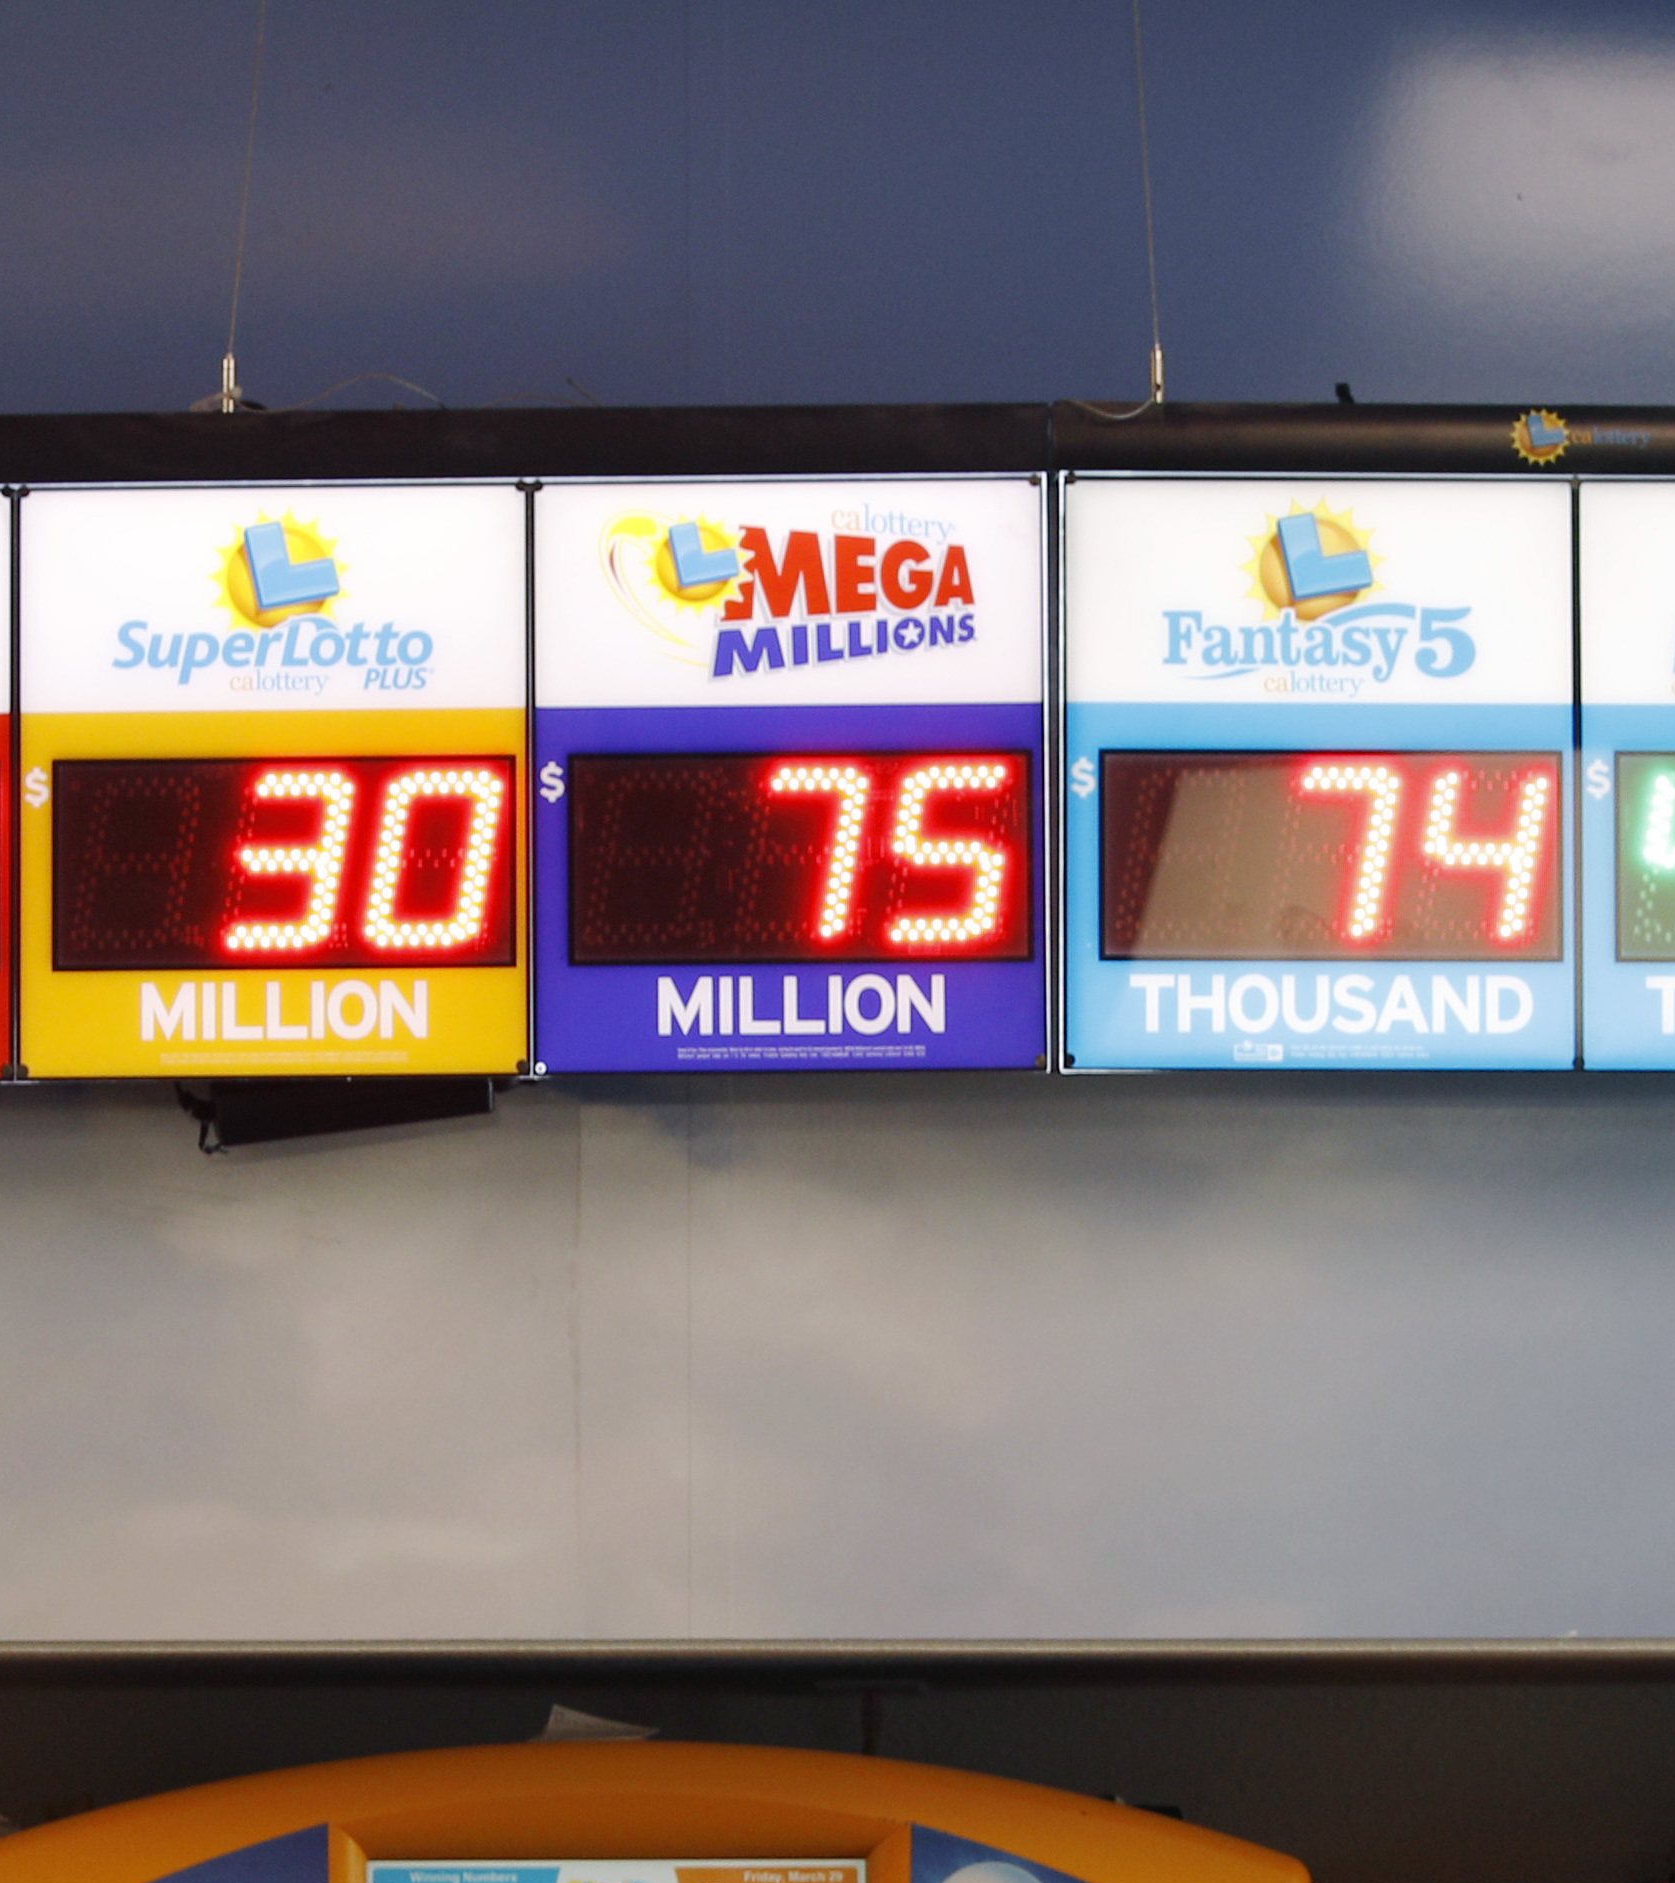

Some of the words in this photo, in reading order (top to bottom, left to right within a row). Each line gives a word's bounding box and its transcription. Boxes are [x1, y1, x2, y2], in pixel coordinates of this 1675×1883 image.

[1570, 426, 1652, 449] calottery
[831, 503, 956, 545] calottery
[721, 524, 977, 622] MEGA
[110, 617, 435, 687] SuperLotto
[362, 667, 434, 691] PLUS
[712, 612, 977, 678] MILLIONS
[1161, 600, 1411, 682] Fantasy
[1414, 605, 1478, 678] 5
[228, 671, 330, 693] calottery
[1263, 669, 1366, 697] calottery
[1586, 758, 1612, 799] $
[24, 765, 51, 809] $
[226, 768, 504, 950] 30
[538, 760, 566, 804] $
[770, 764, 1007, 944] 75
[1070, 757, 1098, 799] $
[1301, 763, 1549, 938] 74
[139, 979, 429, 1043] MILLION
[656, 973, 947, 1037] MILLION
[1128, 973, 1535, 1037] THOUSAND
[463, 1872, 518, 1883] Numbers
[788, 1871, 826, 1882] March
